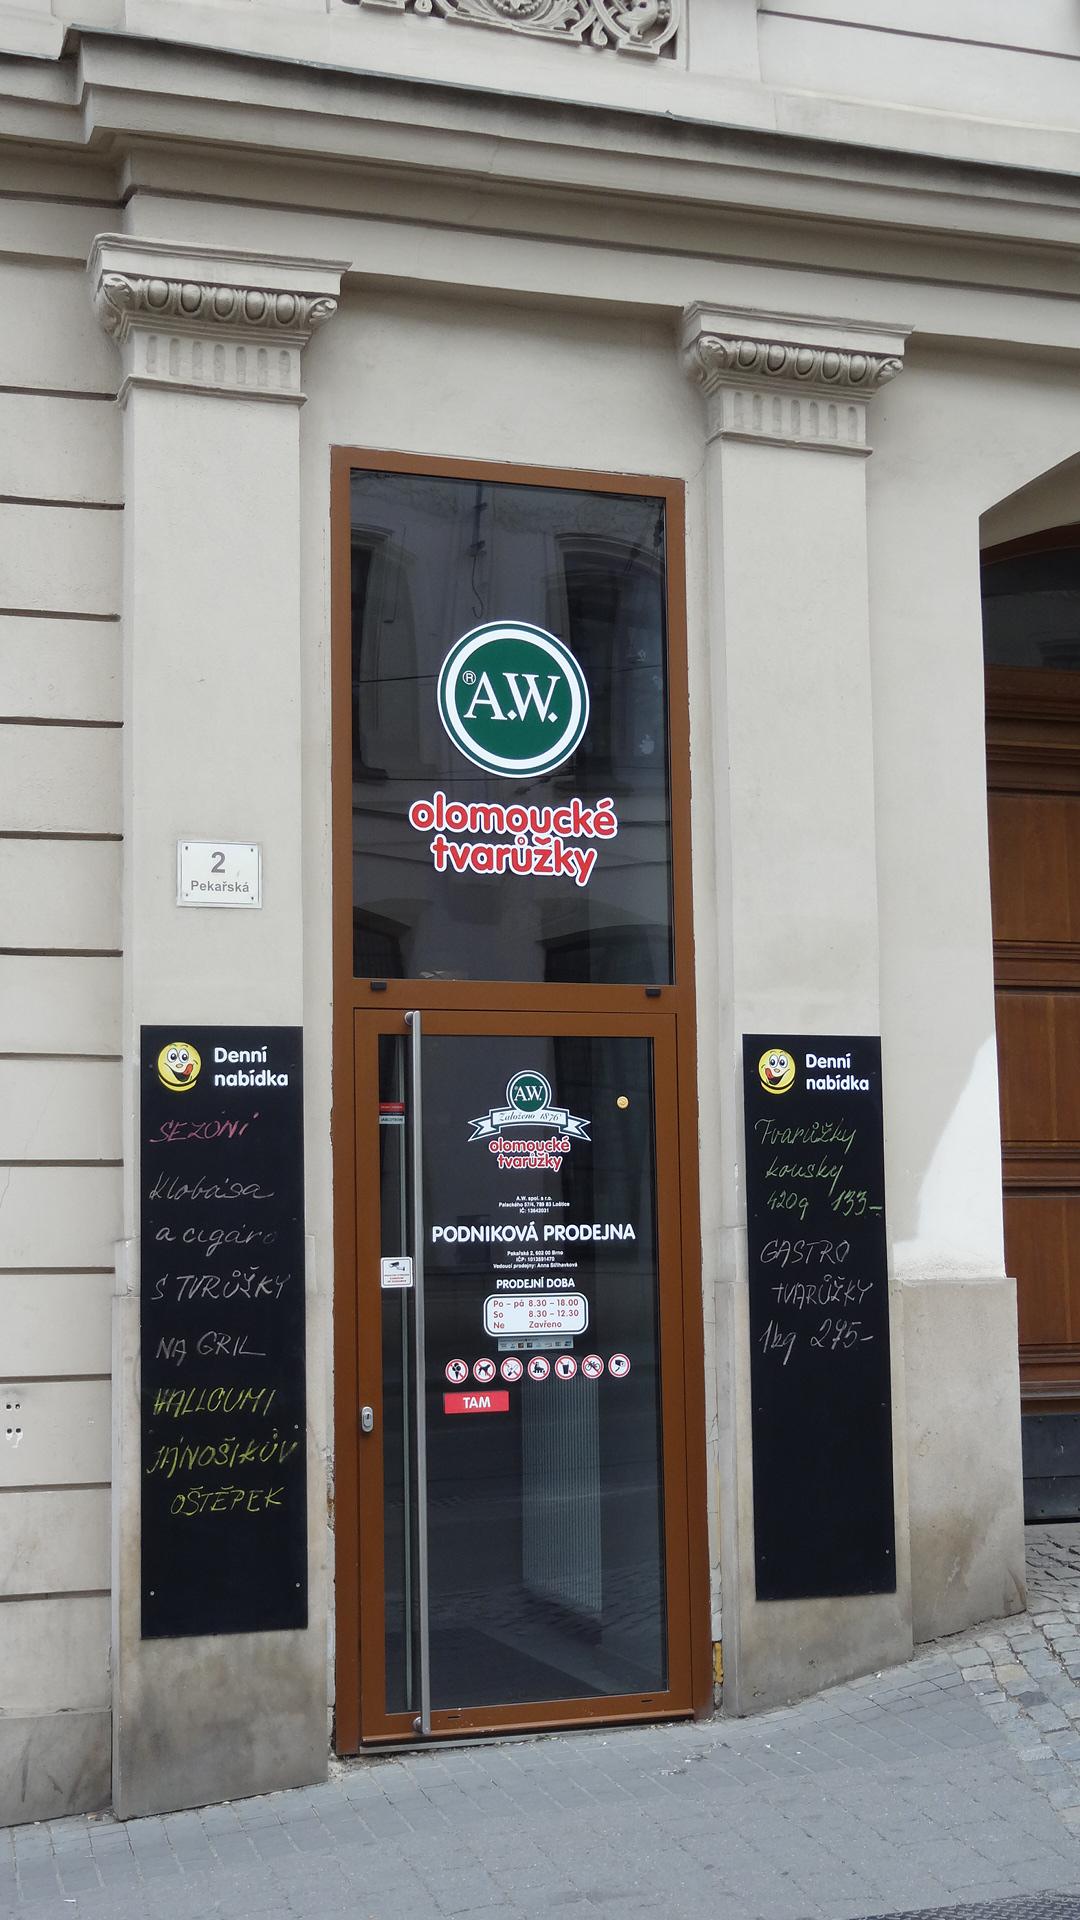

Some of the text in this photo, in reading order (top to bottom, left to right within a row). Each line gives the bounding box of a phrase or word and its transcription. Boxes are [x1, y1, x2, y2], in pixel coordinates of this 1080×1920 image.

[409, 791, 617, 838] olomoucké
[211, 851, 226, 873] 2
[430, 836, 597, 887] tvarůžky
[191, 880, 249, 892] Pekařská
[214, 1046, 268, 1063] Denní
[805, 1053, 851, 1069] Denní
[214, 1070, 289, 1087] nabídka
[806, 1075, 869, 1091] nabídka
[489, 1136, 571, 1153] olomoucké
[497, 1152, 562, 1172] tvarůžky
[155, 1226, 176, 1242] a
[432, 1221, 636, 1243] PODNIKOVÁ PRODEJNA
[760, 1238, 850, 1268] GASTRO
[496, 1276, 575, 1289] PRODEJNÍ DOBA
[493, 1300, 504, 1308] Po
[513, 1299, 524, 1309] pá
[528, 1299, 547, 1307] 8.30
[557, 1299, 579, 1307] 18.00
[493, 1311, 504, 1319] So
[528, 1310, 547, 1318] 8.30
[557, 1309, 579, 1317] 12.30
[529, 1320, 562, 1328] Zavřeno
[156, 1331, 267, 1367] NA GRIL
[462, 1396, 491, 1409] TAM
